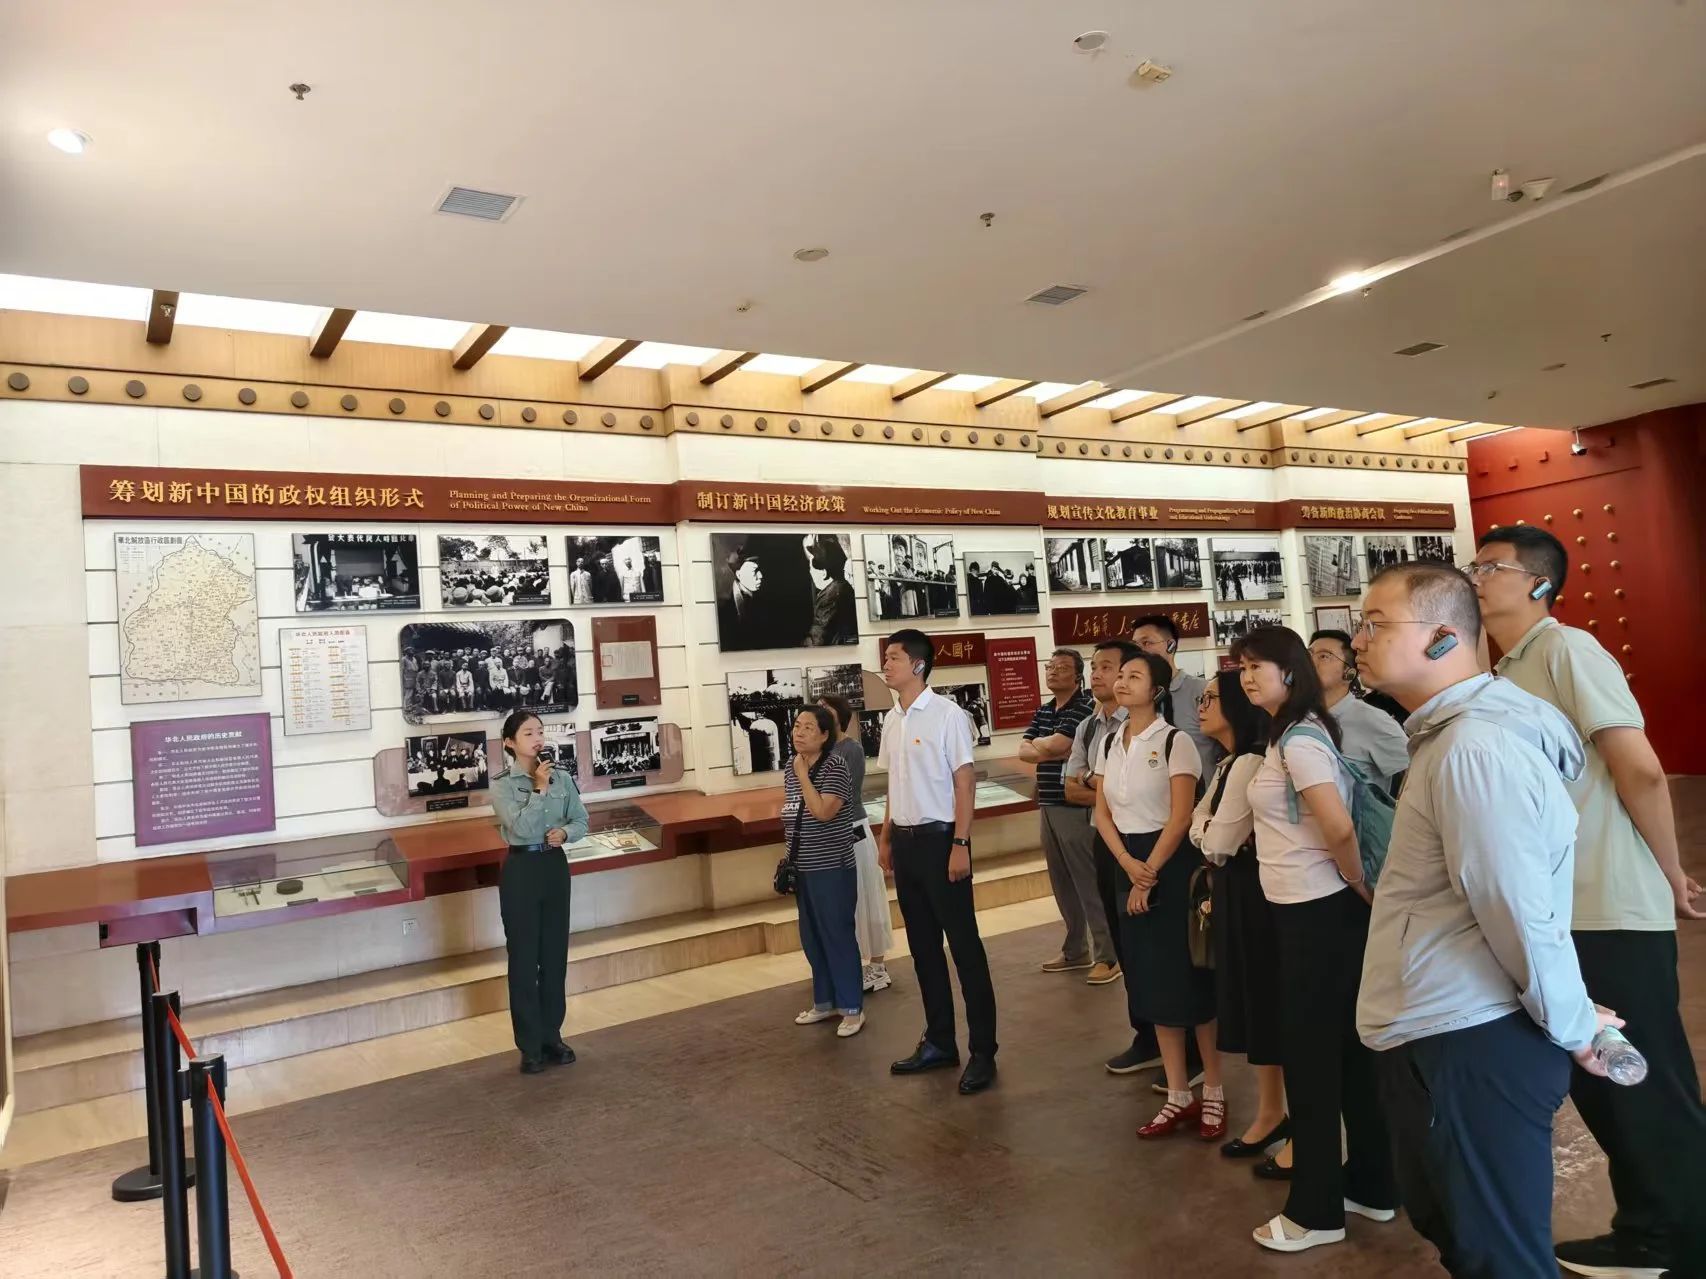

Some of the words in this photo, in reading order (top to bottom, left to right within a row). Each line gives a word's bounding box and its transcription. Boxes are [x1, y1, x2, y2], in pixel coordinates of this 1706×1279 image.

[109, 479, 424, 508] 筹划新中国的政权组织形式
[449, 490, 489, 501] Planning
[491, 492, 507, 500] and
[510, 492, 552, 503] Preparing
[554, 494, 567, 502] the
[569, 494, 628, 505] Organizational
[450, 501, 460, 509] of
[462, 502, 499, 510] Political
[502, 503, 529, 511] Power
[531, 503, 542, 511] of
[565, 504, 589, 512] China
[697, 491, 846, 513] 制订新中国经济政策
[863, 506, 889, 515] Working
[1047, 504, 1159, 521] 规划宣传文化教育事业
